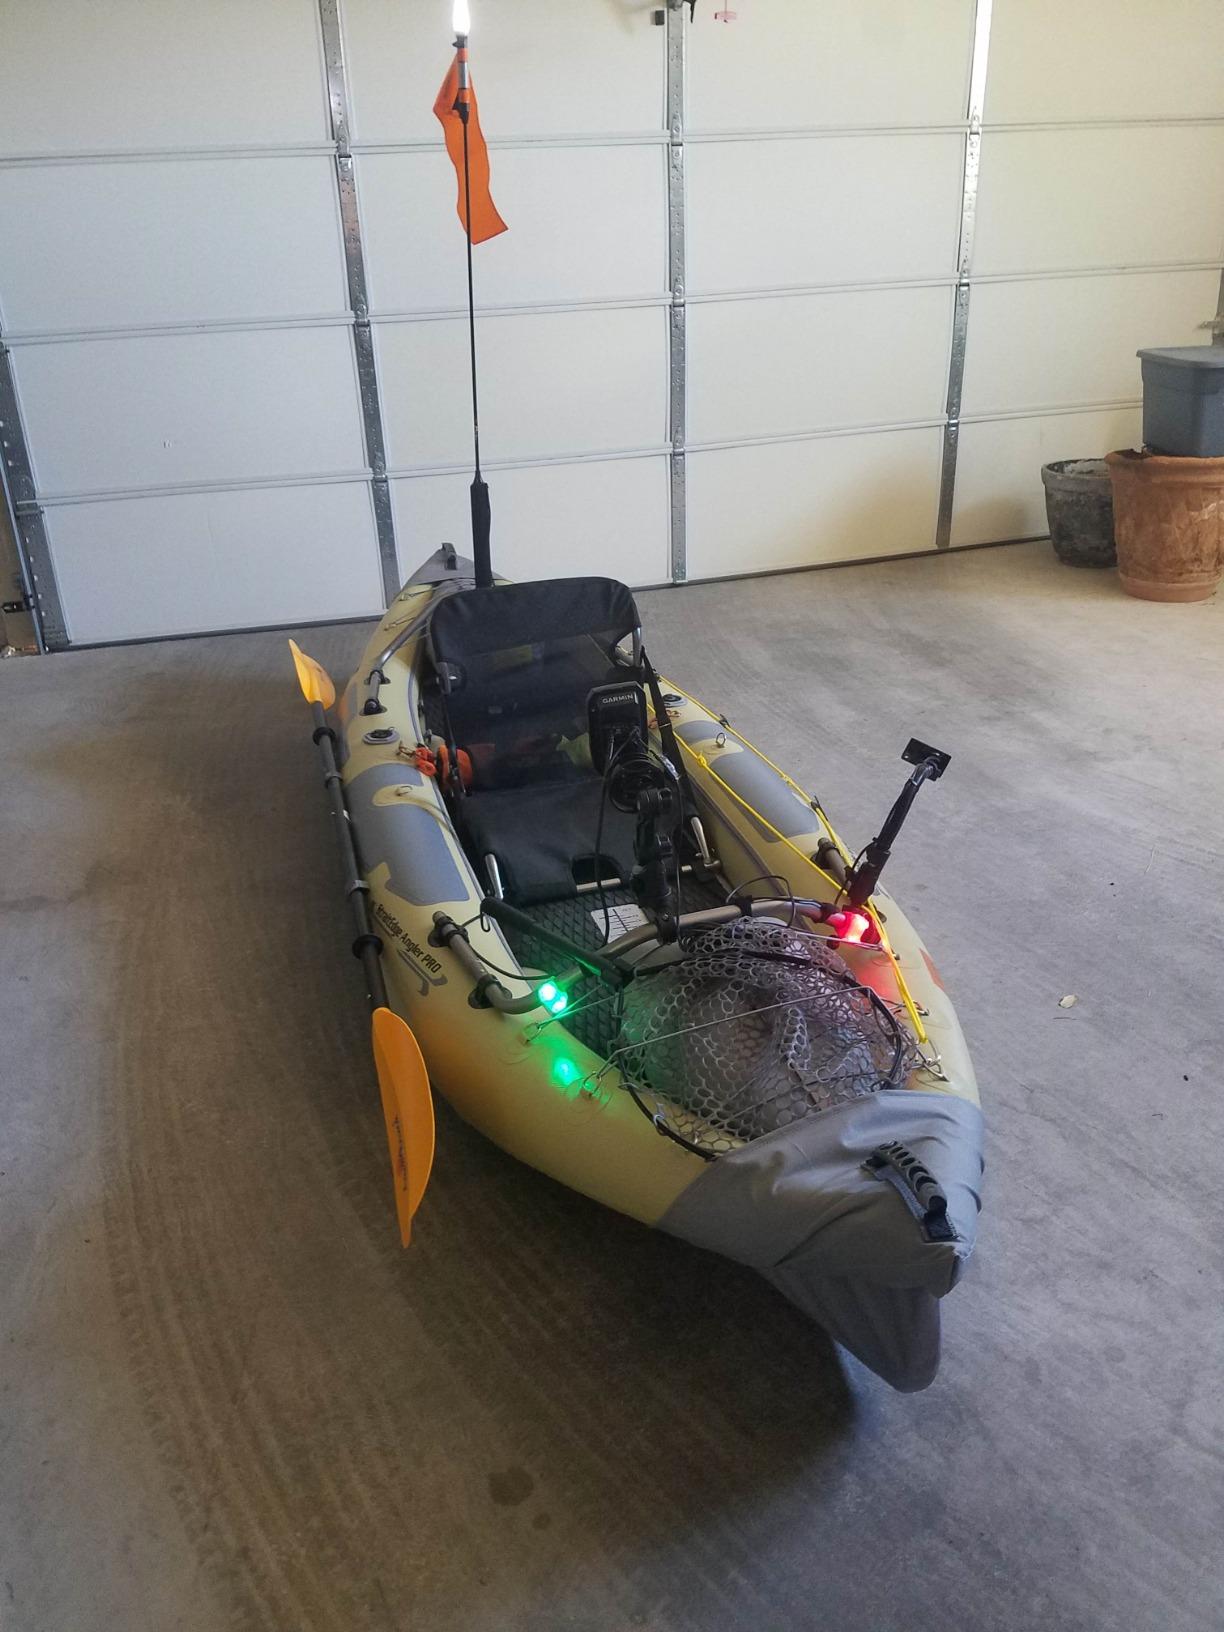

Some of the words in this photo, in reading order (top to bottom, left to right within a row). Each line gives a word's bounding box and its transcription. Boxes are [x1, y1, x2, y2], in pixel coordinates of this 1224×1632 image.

[602, 694, 634, 704] GARMIN
[400, 933, 424, 958] Angler
[421, 954, 442, 973] PRO
